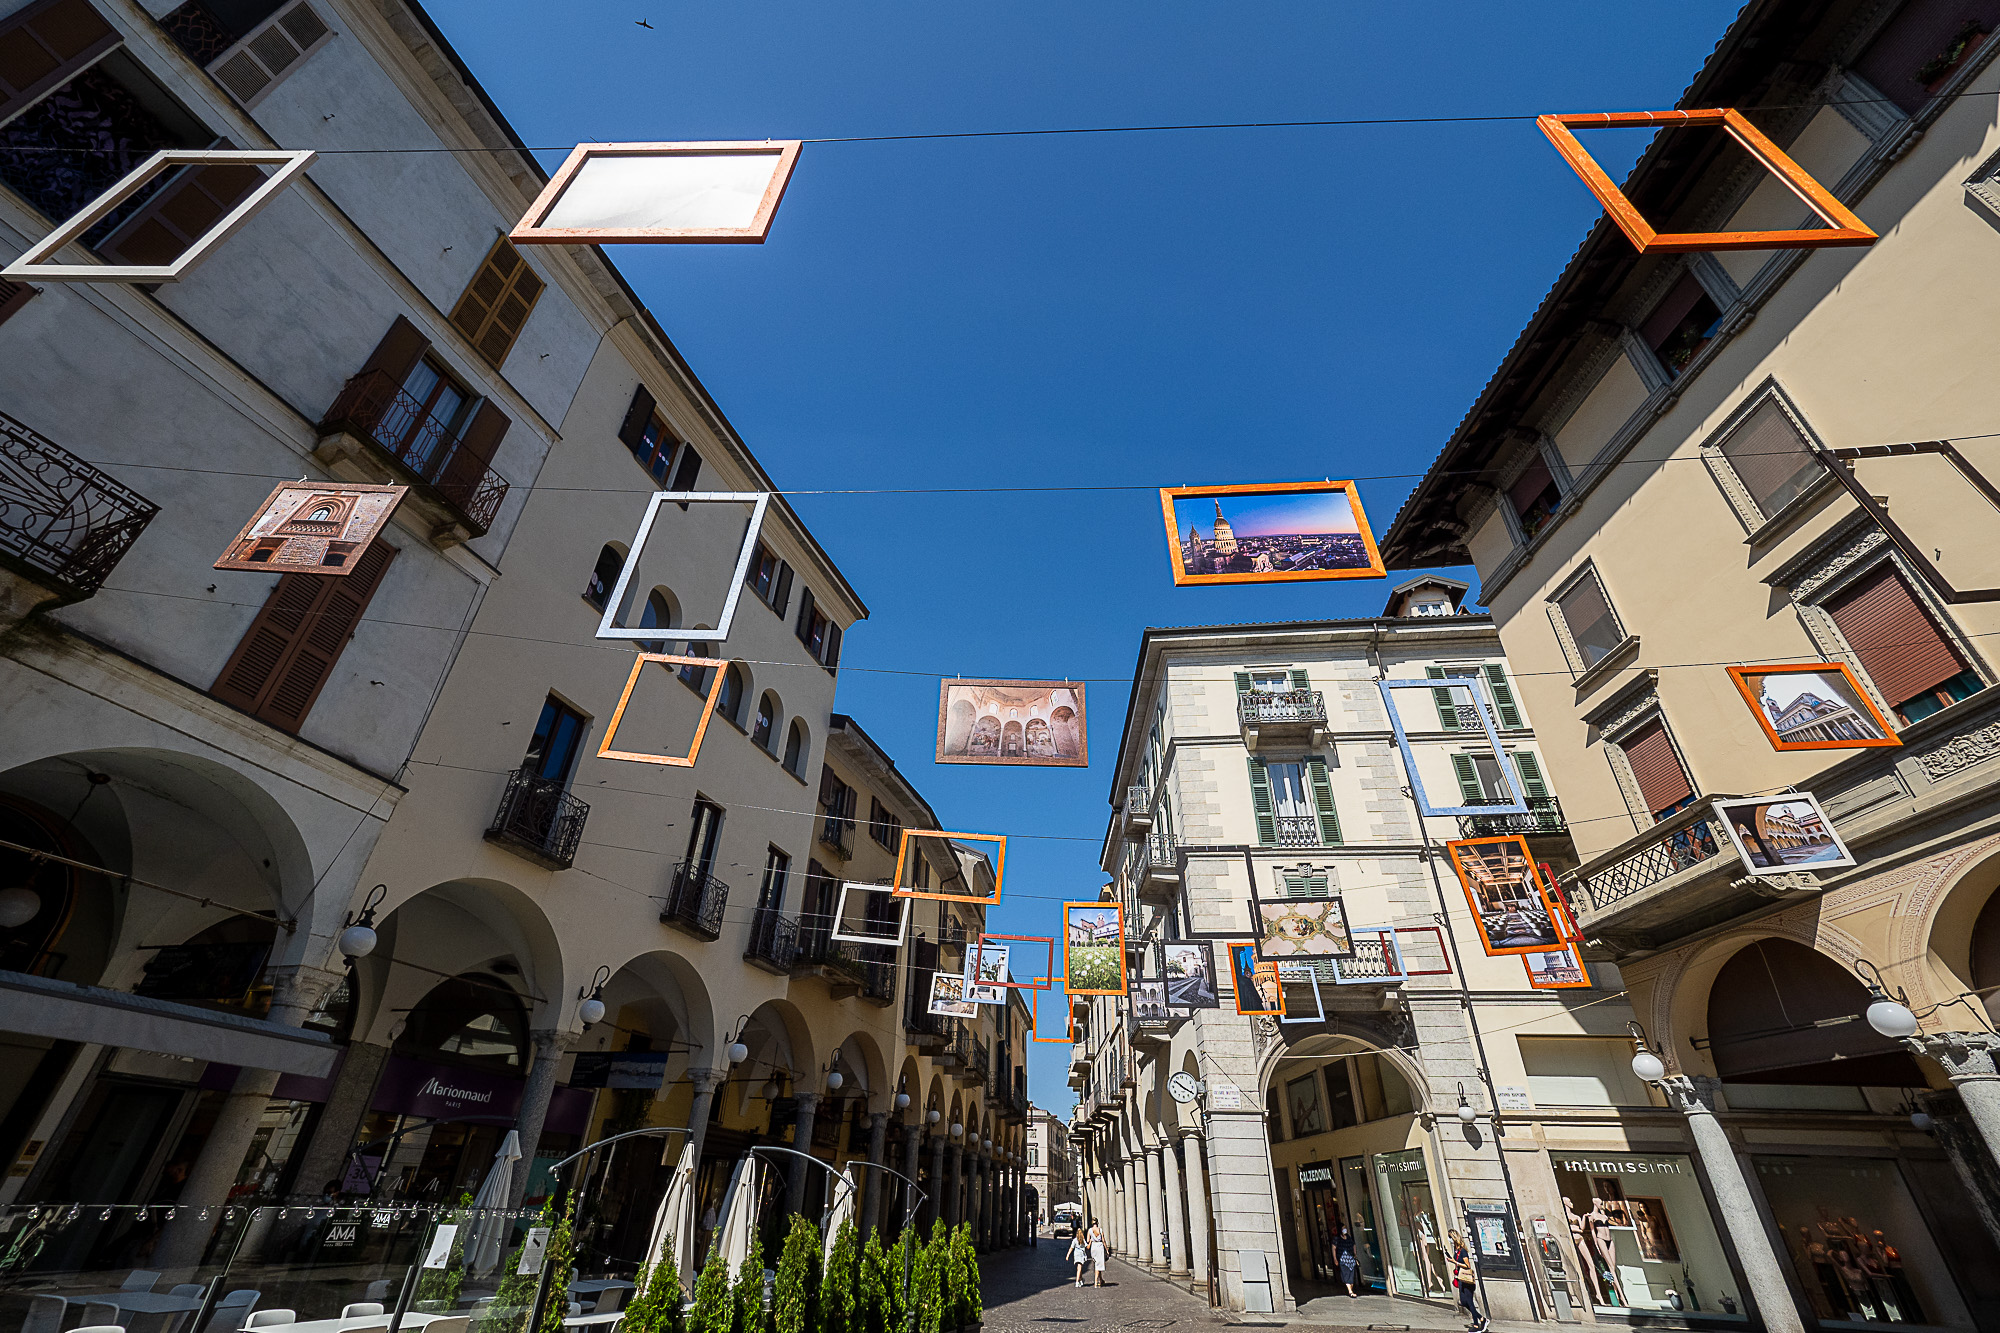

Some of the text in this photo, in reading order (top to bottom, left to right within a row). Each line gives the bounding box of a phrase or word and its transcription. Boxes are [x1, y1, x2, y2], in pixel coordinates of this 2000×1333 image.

[416, 1077, 492, 1103] Marionnaud
[445, 1101, 462, 1109] PARIS
[1564, 1159, 1681, 1174] intimissimi
[1299, 1168, 1332, 1182] CALZEDONIA
